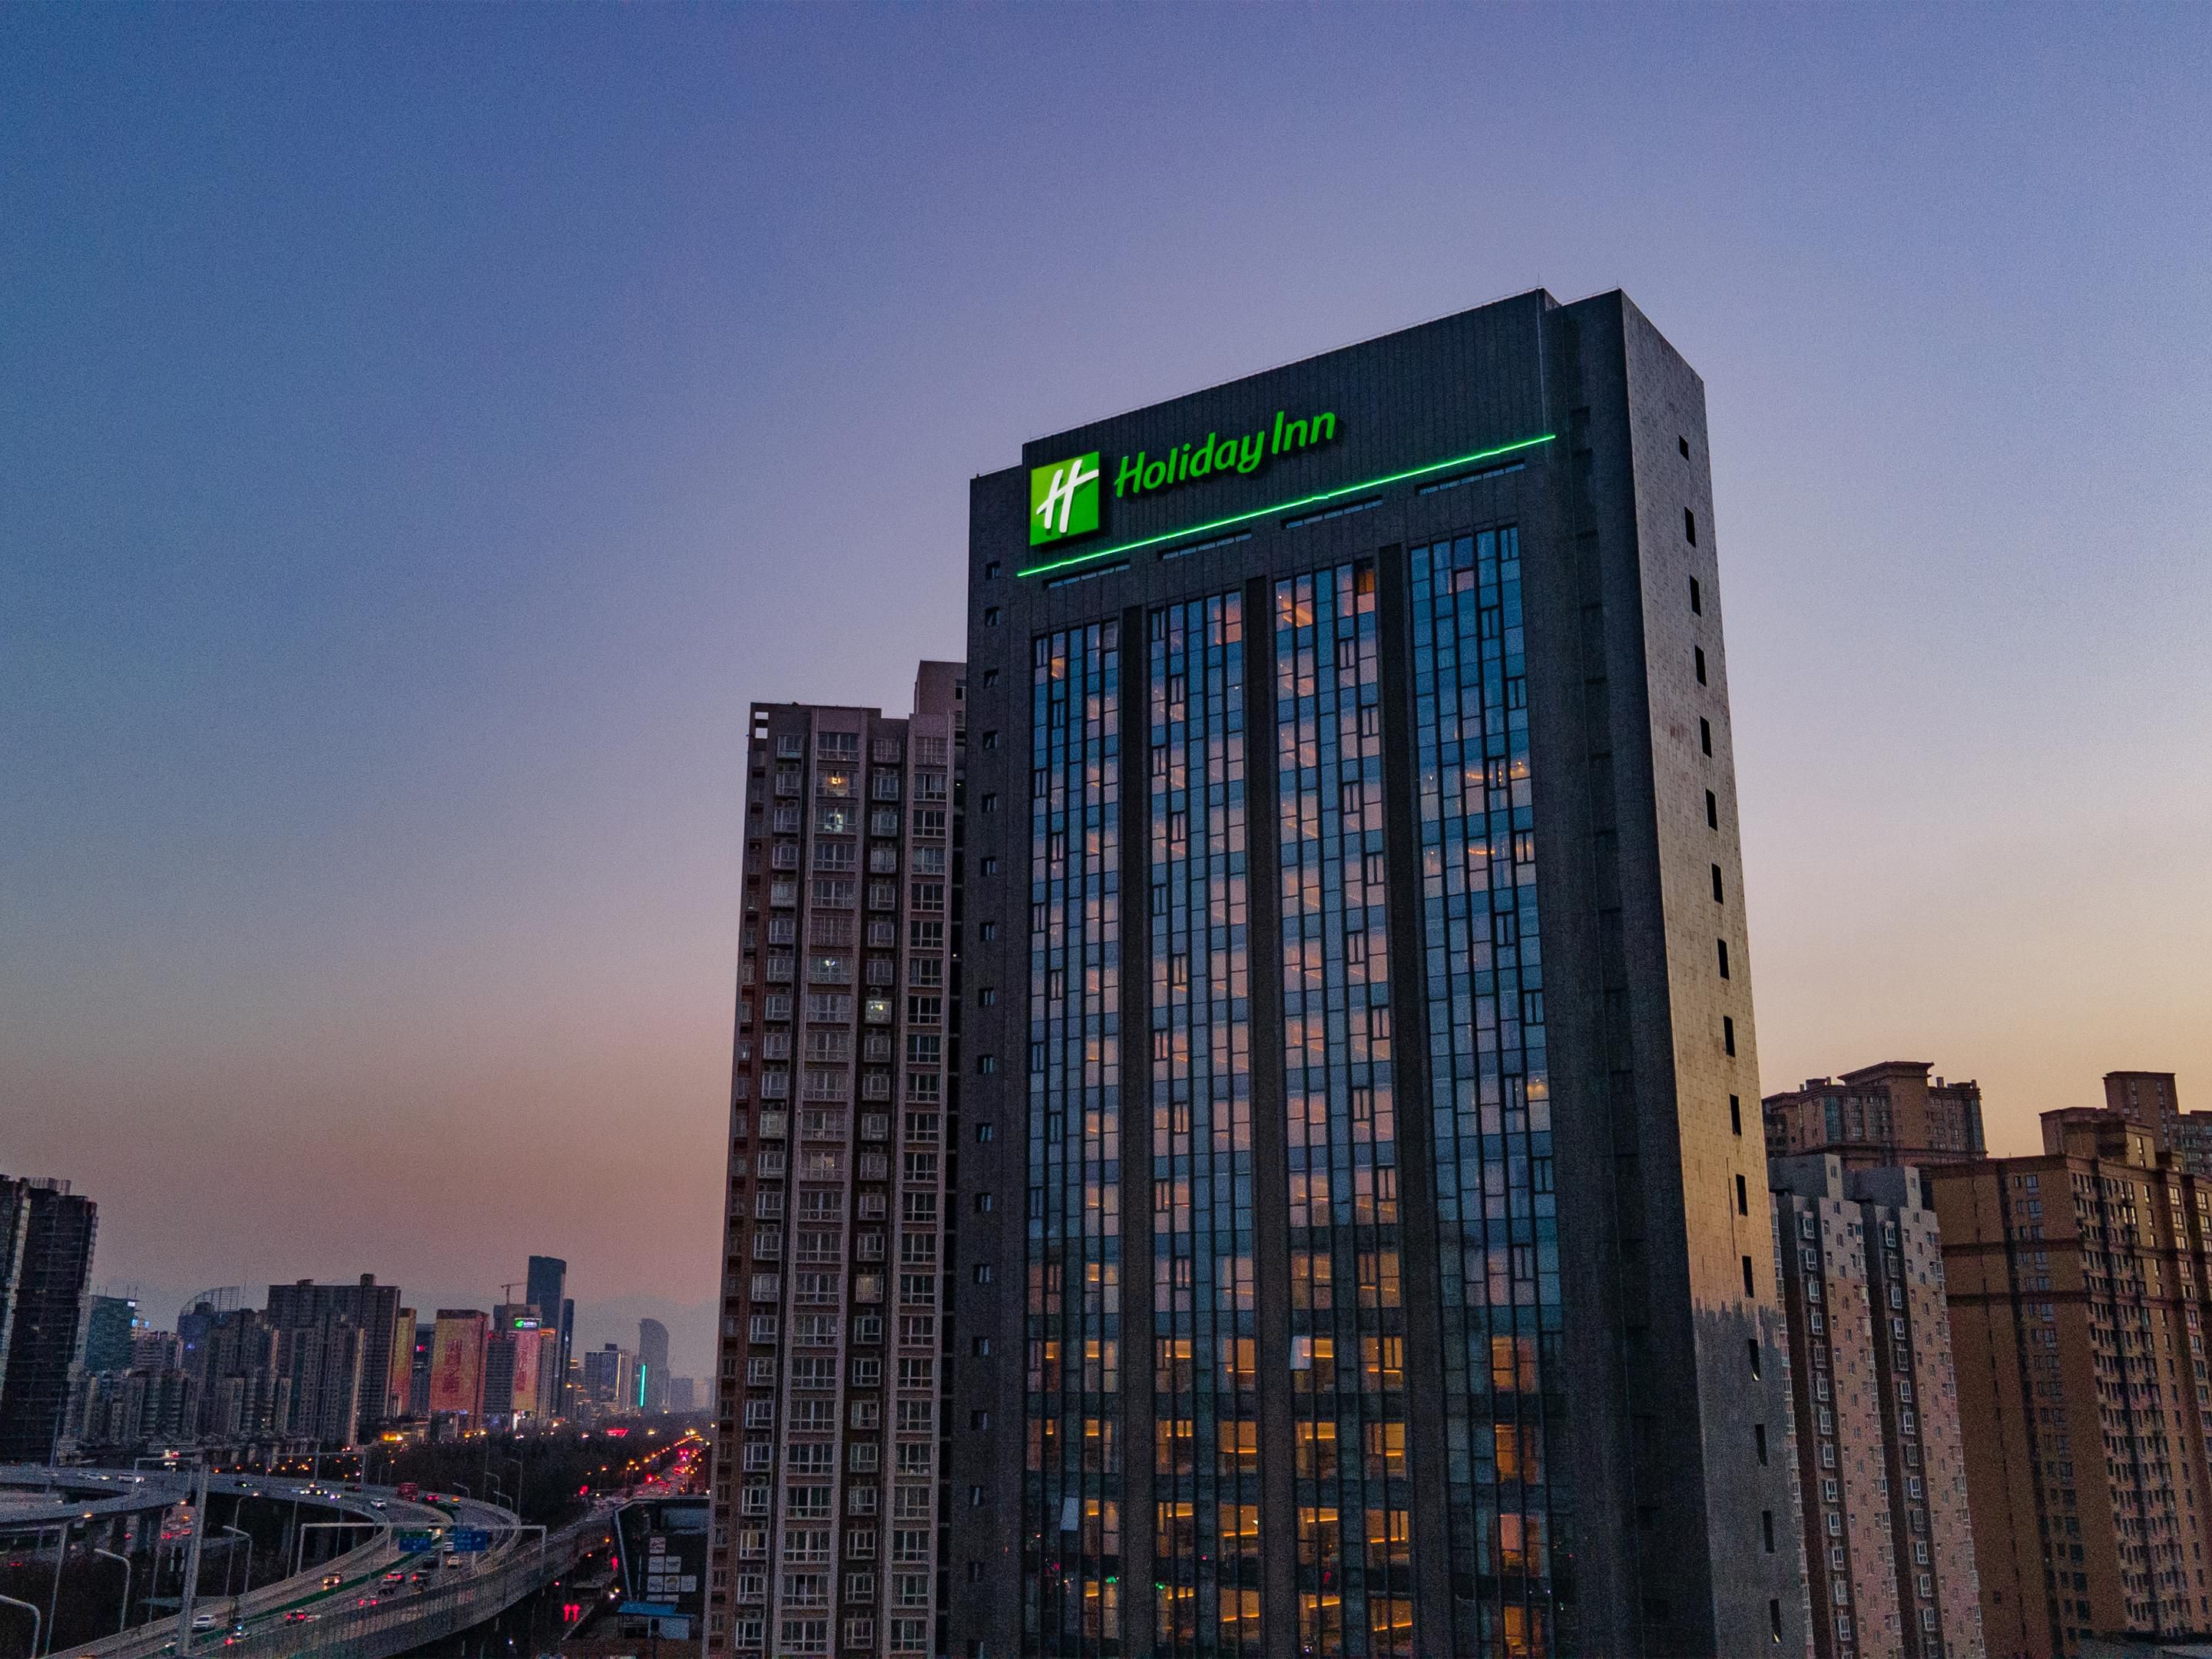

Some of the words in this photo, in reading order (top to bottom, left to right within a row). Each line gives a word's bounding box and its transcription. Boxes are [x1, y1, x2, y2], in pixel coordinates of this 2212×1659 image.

[1114, 431, 1265, 498] Holiday
[1271, 411, 1336, 455] Inn
[1036, 459, 1098, 533] H
